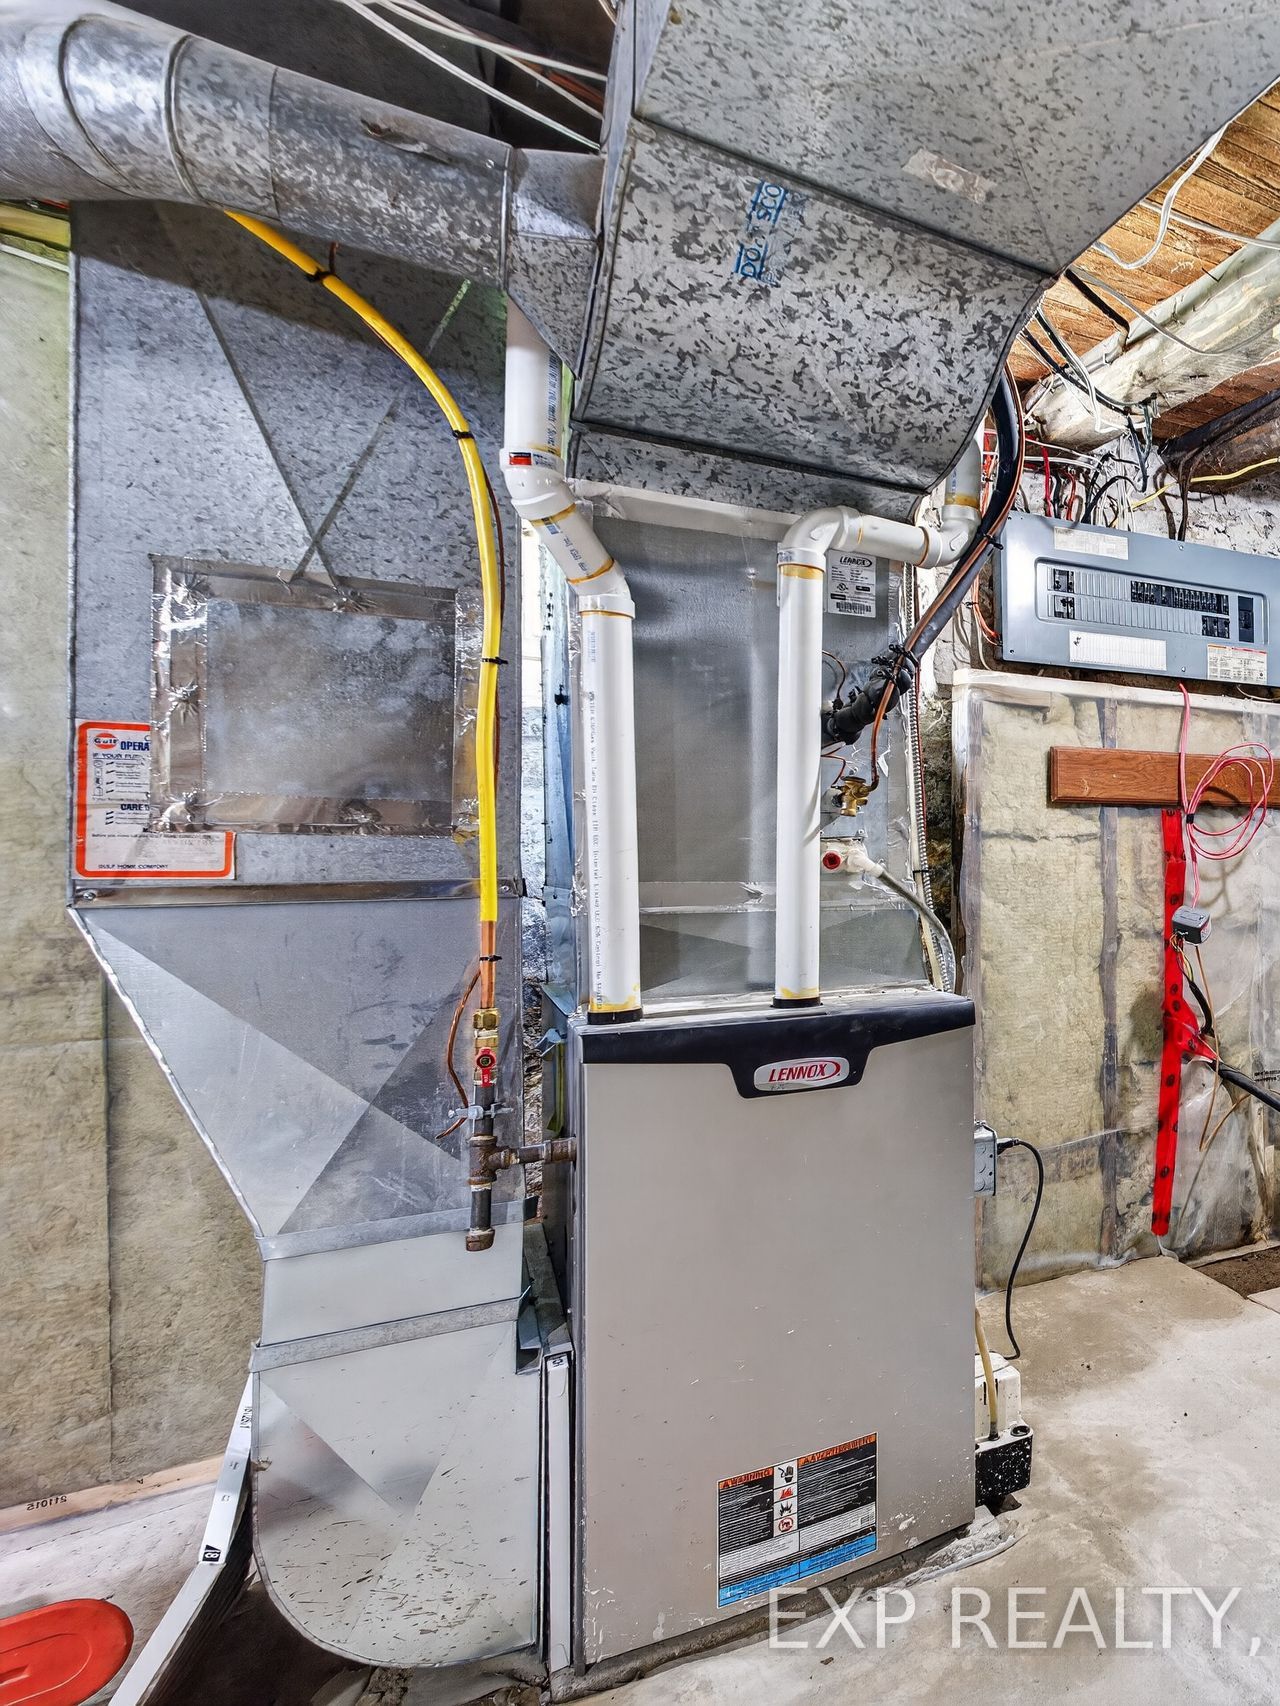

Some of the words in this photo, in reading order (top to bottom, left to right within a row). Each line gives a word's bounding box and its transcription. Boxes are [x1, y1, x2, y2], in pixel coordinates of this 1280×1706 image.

[740, 184, 781, 278] DOSCO
[120, 803, 143, 811] CARE
[768, 1063, 828, 1082] LENNOX
